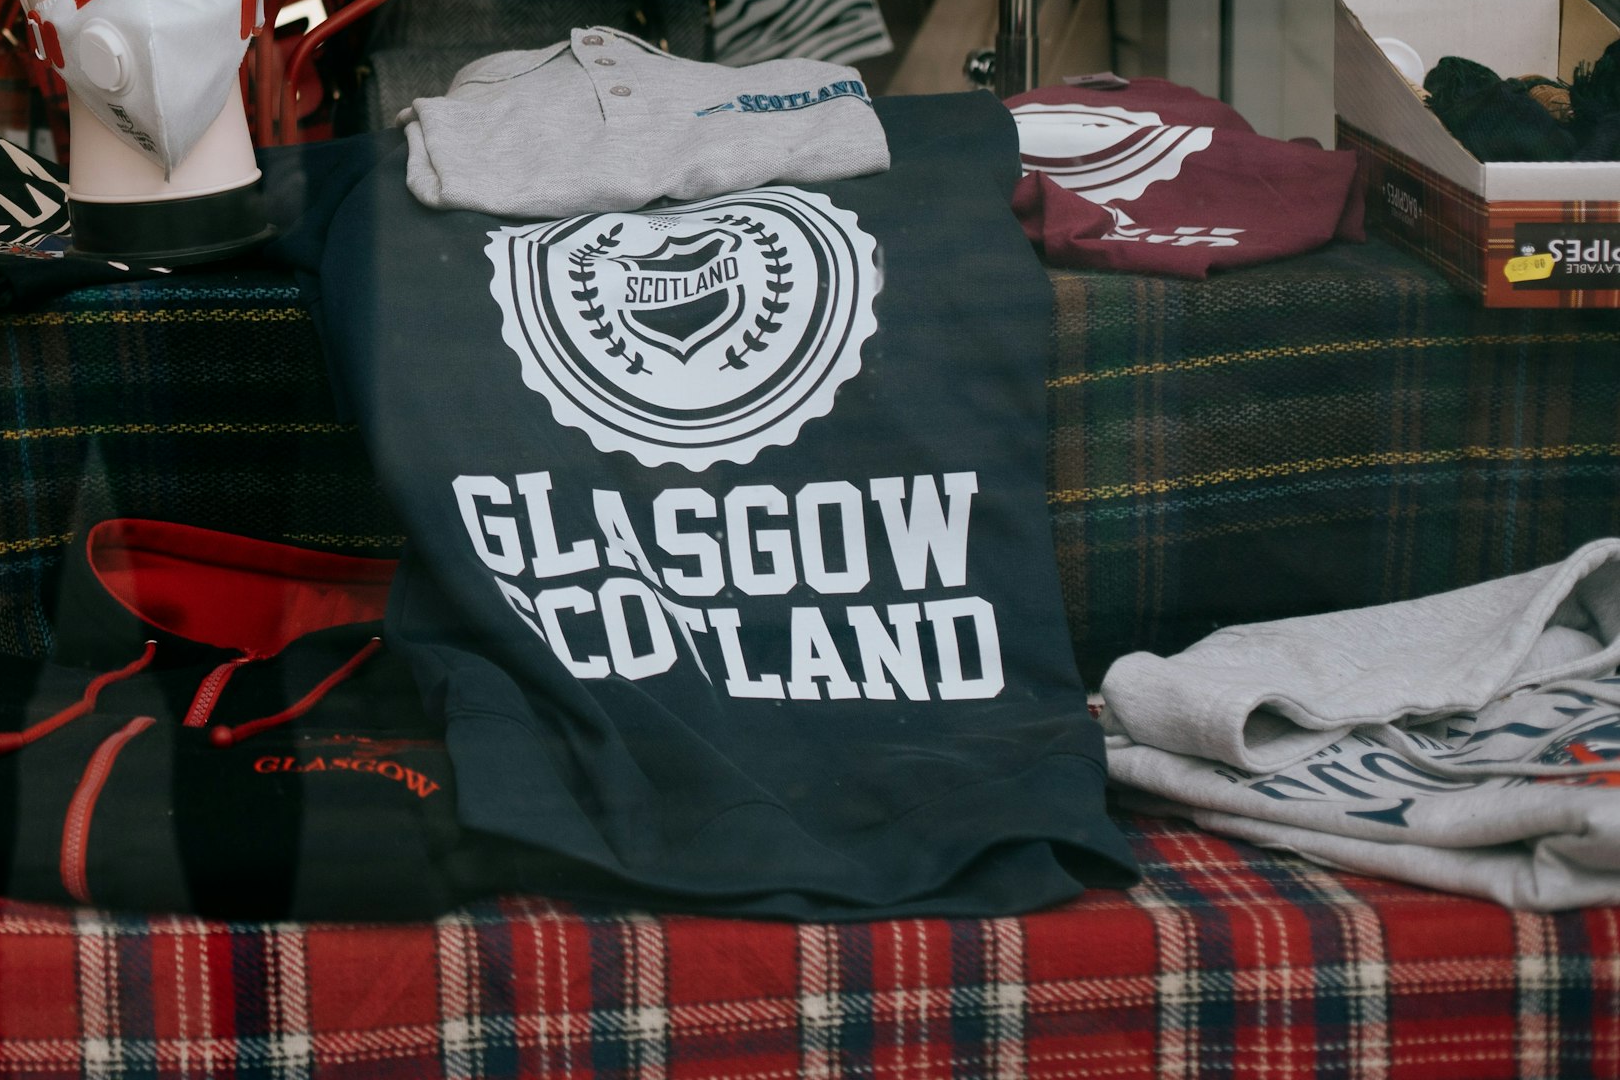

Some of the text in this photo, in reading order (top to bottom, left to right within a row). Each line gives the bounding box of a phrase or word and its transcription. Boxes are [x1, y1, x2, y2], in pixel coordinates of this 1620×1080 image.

[736, 80, 867, 112] SCOTLAND
[624, 256, 739, 303] SCOTLAND
[1566, 264, 1620, 274] LAYABLE
[451, 471, 979, 596] GLASGOW
[253, 755, 441, 799] GLASGOW
